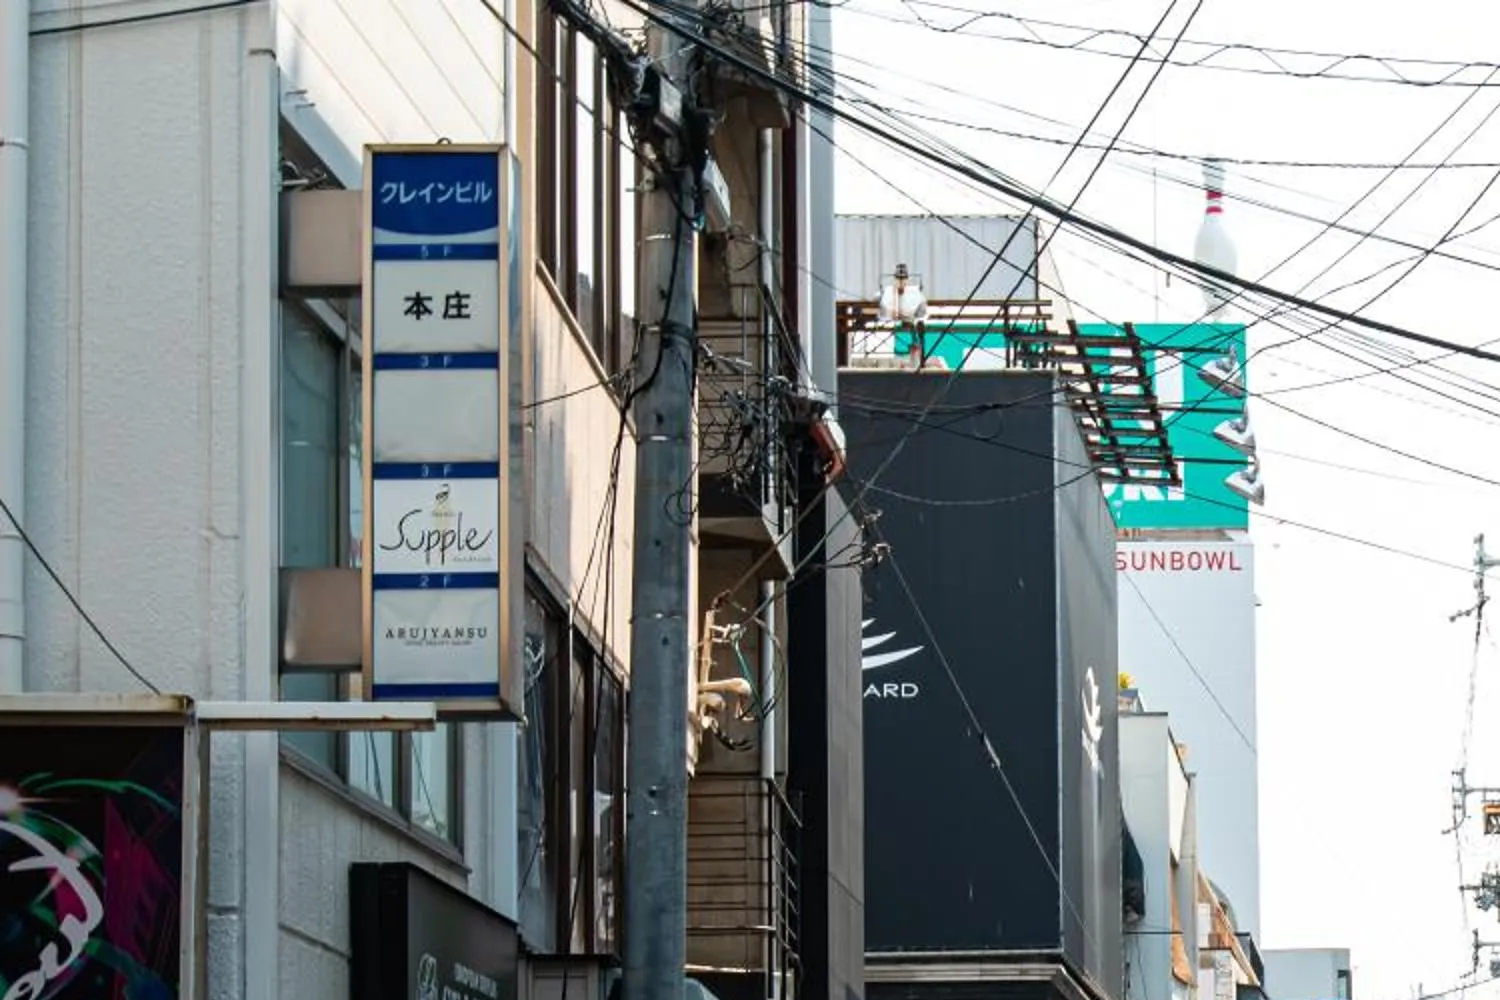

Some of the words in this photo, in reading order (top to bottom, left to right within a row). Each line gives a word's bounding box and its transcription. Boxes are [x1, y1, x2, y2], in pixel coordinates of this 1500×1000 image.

[380, 181, 492, 204] クレインビル
[1114, 551, 1242, 572] SUNBOWL
